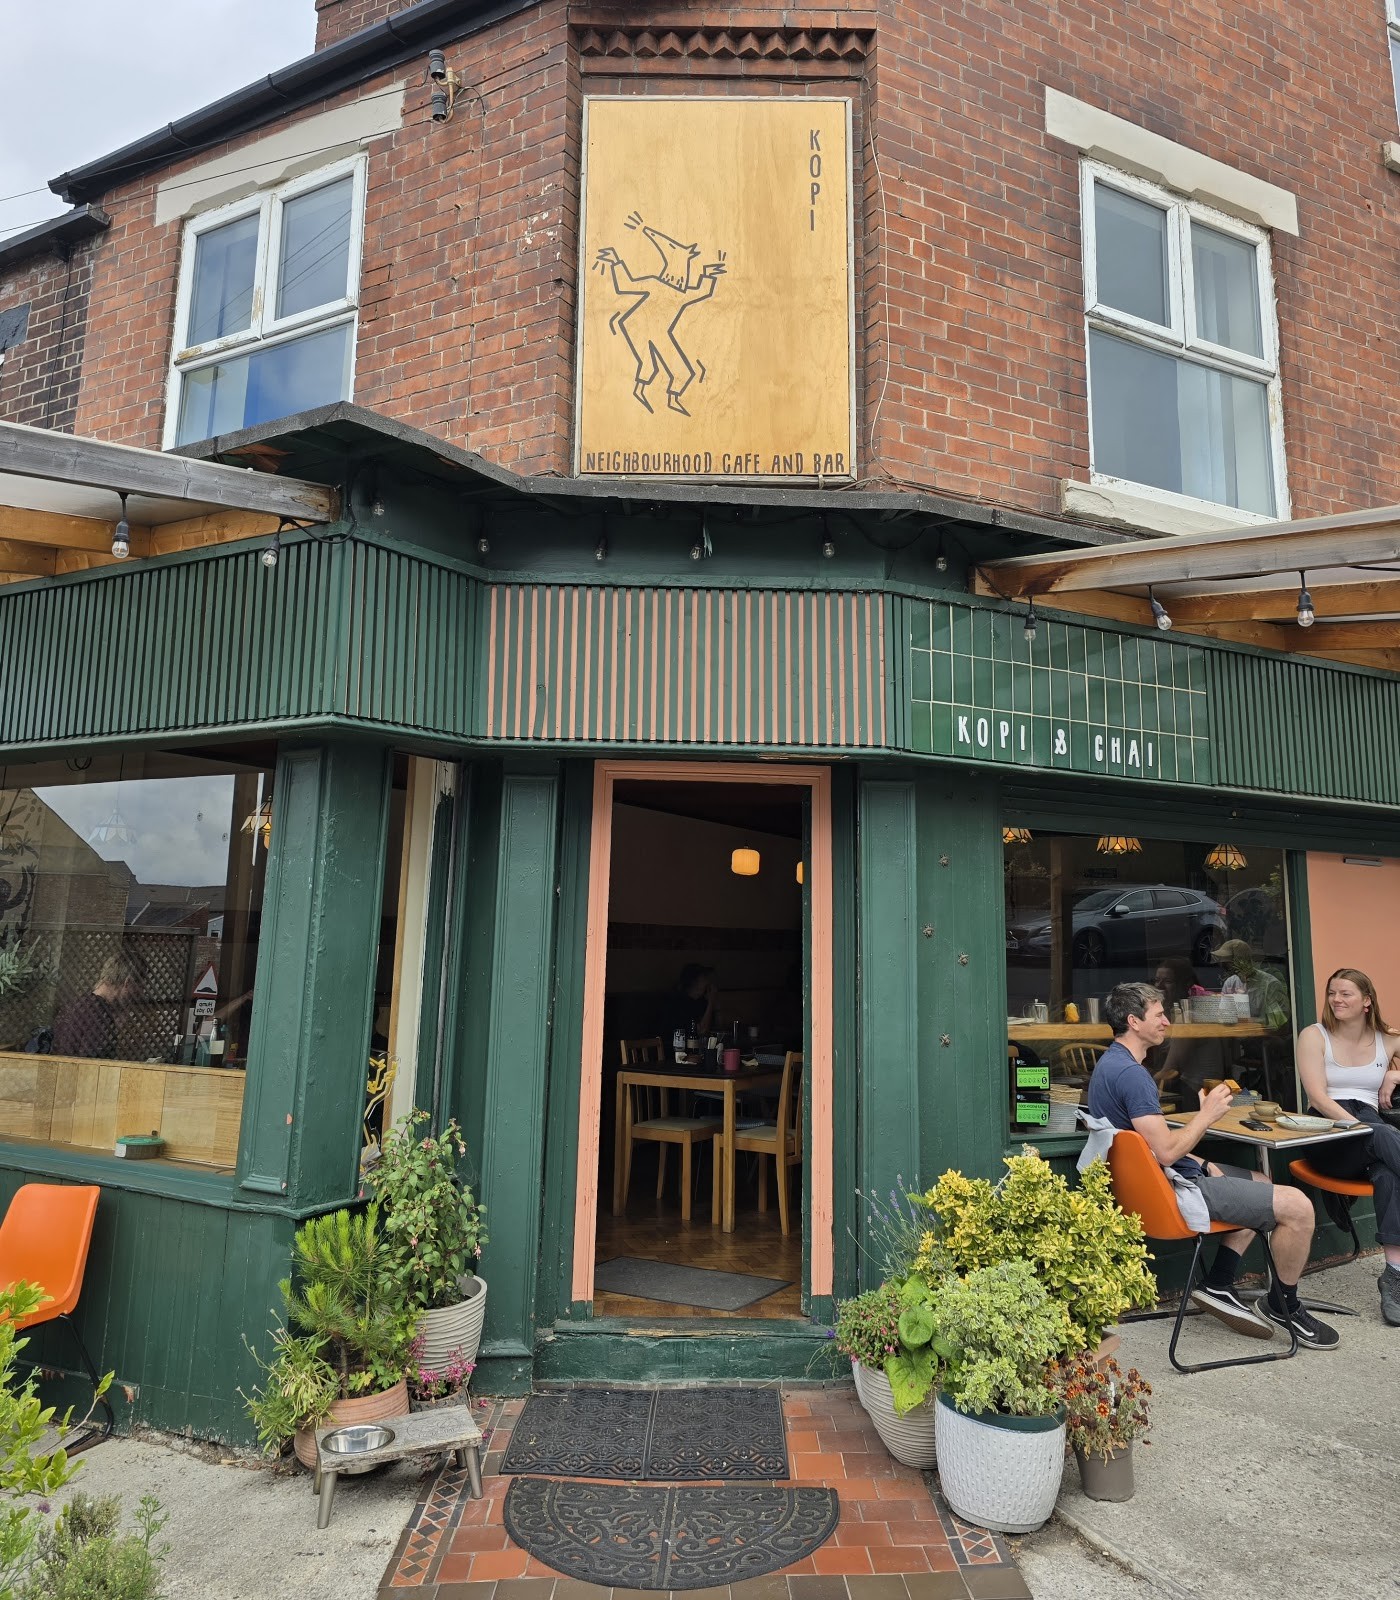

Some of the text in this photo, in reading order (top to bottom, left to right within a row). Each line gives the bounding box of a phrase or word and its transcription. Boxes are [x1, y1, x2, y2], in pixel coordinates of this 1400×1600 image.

[810, 129, 822, 232] KOPI
[586, 451, 845, 474] NEIGHBOURHOOD CAFE AND BAR
[958, 716, 1153, 768] KOPI & CHAI
